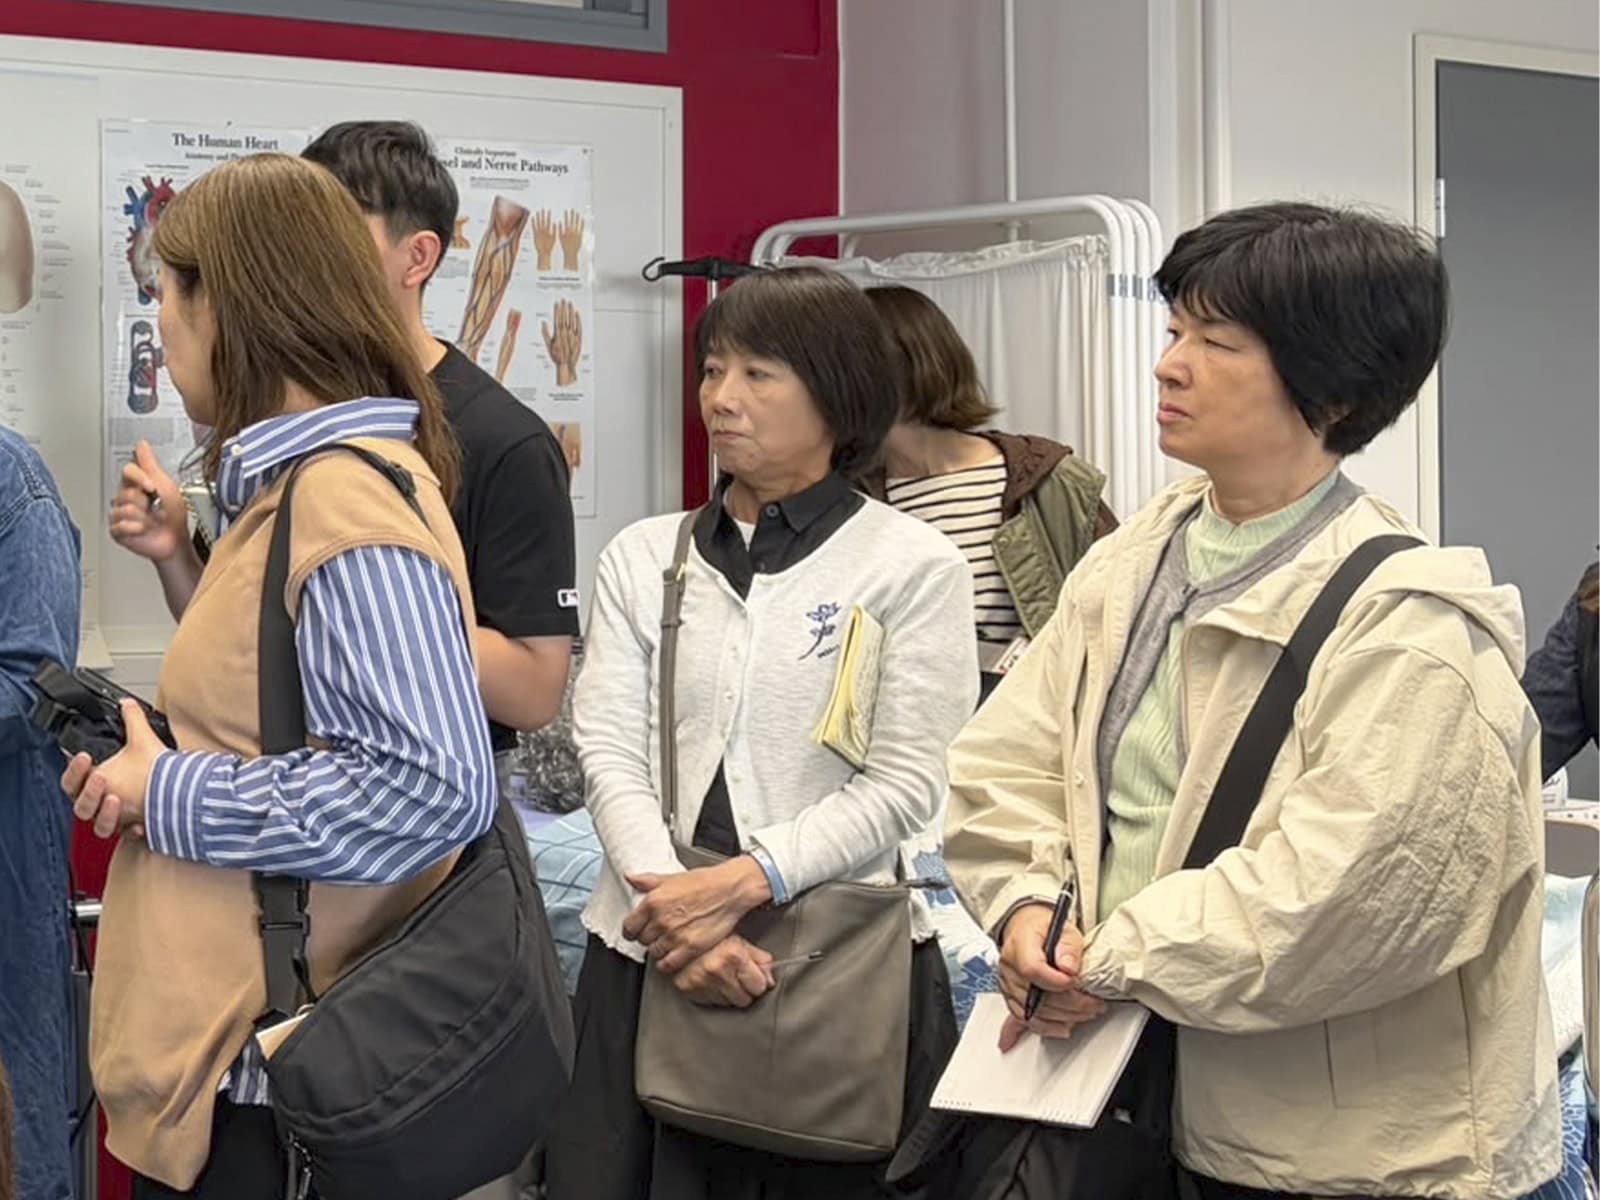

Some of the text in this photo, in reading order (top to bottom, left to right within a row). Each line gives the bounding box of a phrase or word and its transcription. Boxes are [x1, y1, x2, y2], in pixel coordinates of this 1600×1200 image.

[171, 132, 279, 150] The Human Heart
[461, 157, 482, 170] and
[484, 158, 518, 172] Nerve
[520, 159, 569, 177] Pathways
